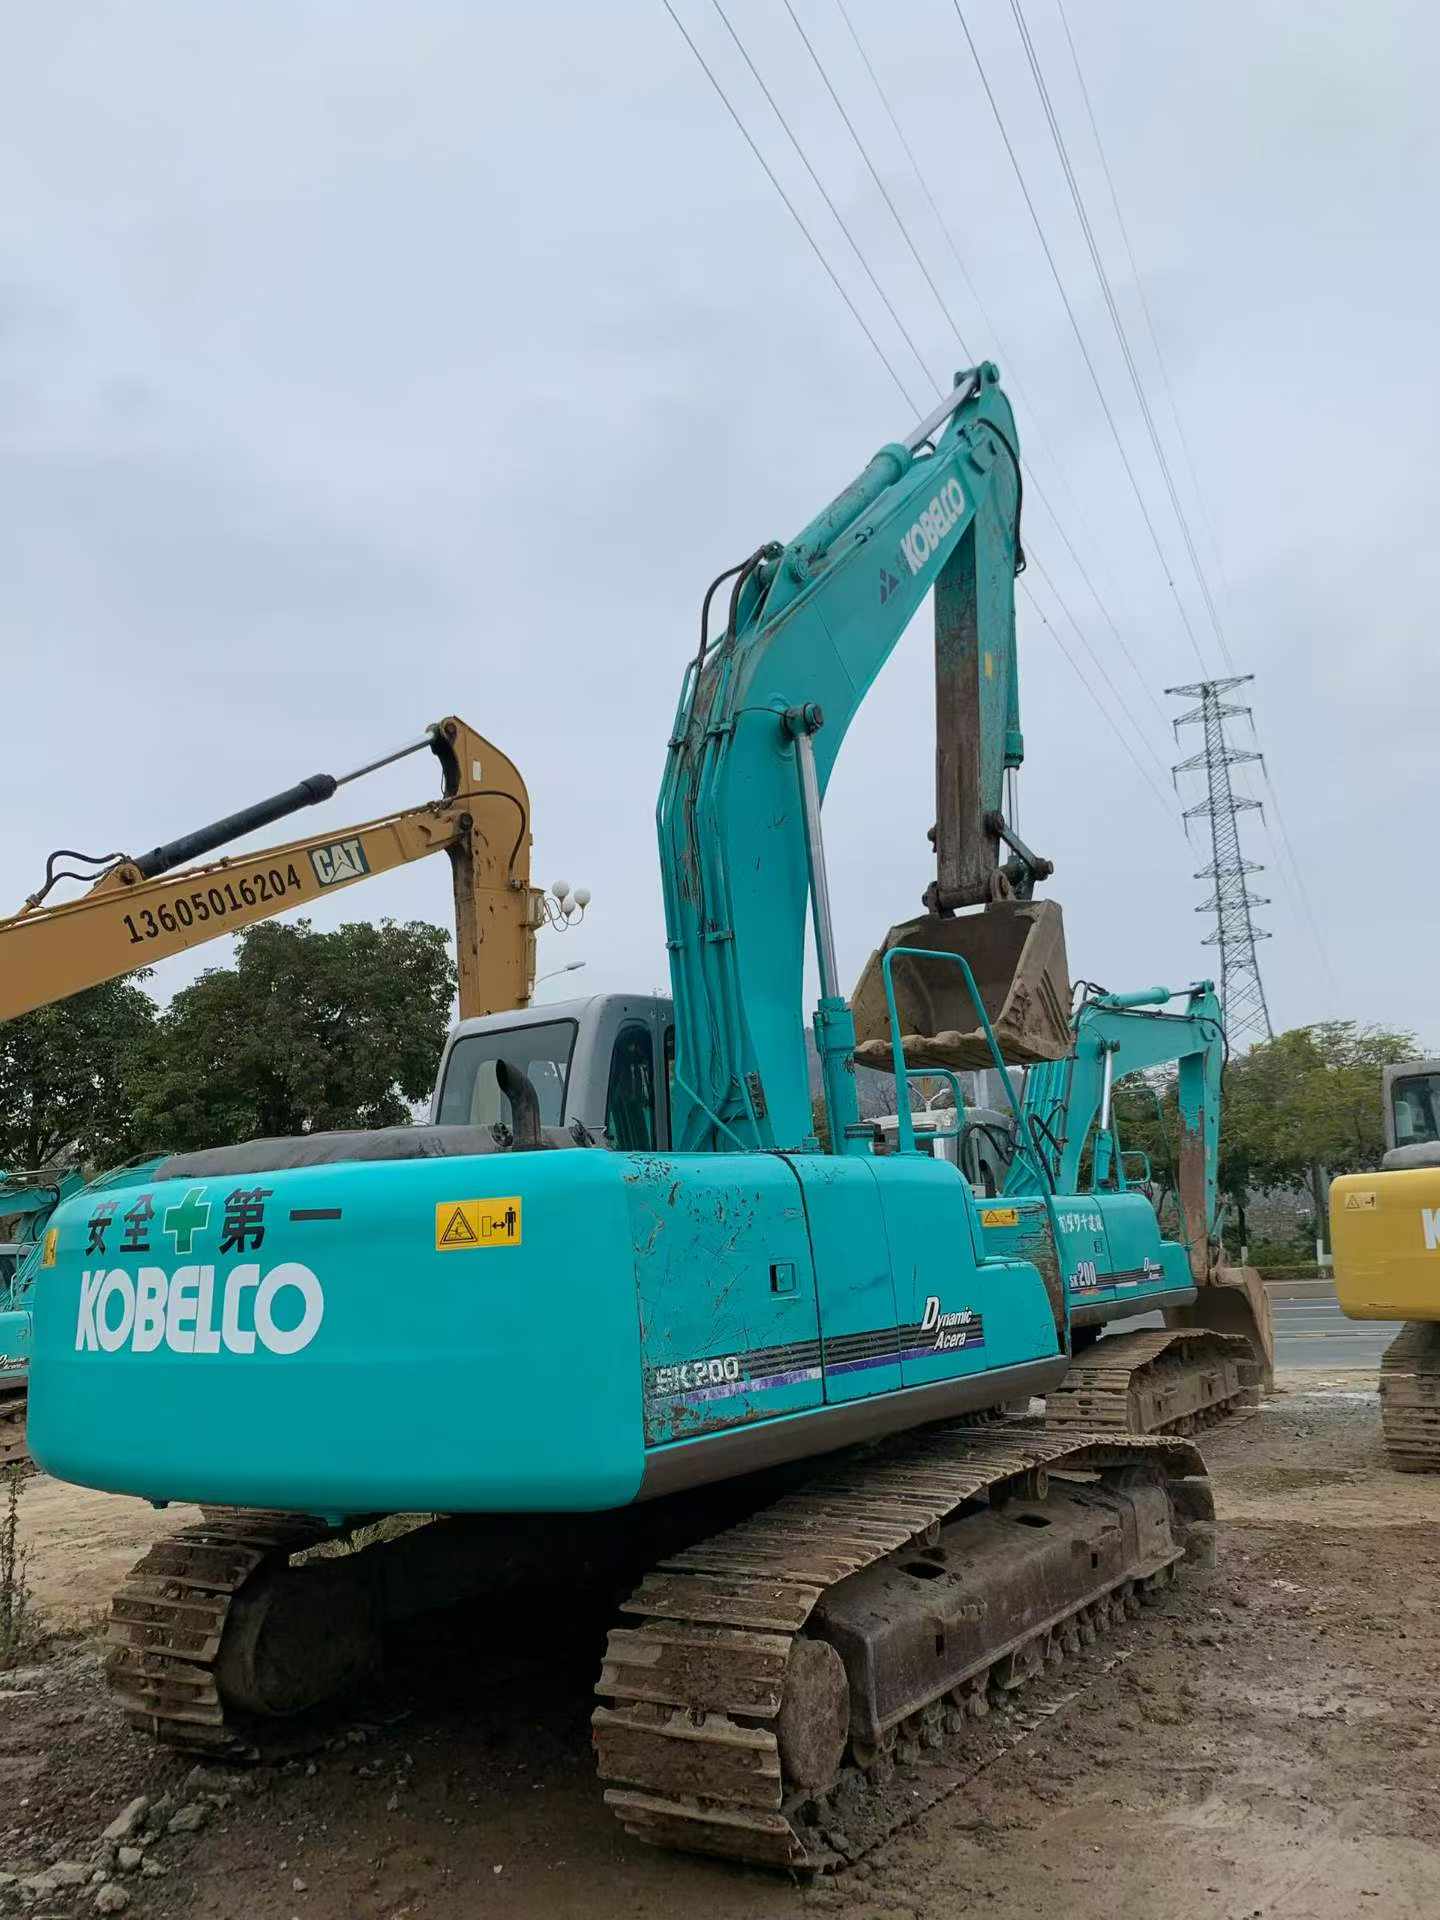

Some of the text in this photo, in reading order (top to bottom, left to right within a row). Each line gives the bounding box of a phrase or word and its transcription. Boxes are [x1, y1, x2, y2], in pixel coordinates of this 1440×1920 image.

[901, 478, 965, 576] KOBELCO
[312, 839, 365, 884] CAT
[123, 863, 302, 944] 13605016204
[75, 1262, 325, 1355] KOBELCO
[921, 1296, 972, 1333] Dynamic
[933, 1331, 966, 1350] Acera
